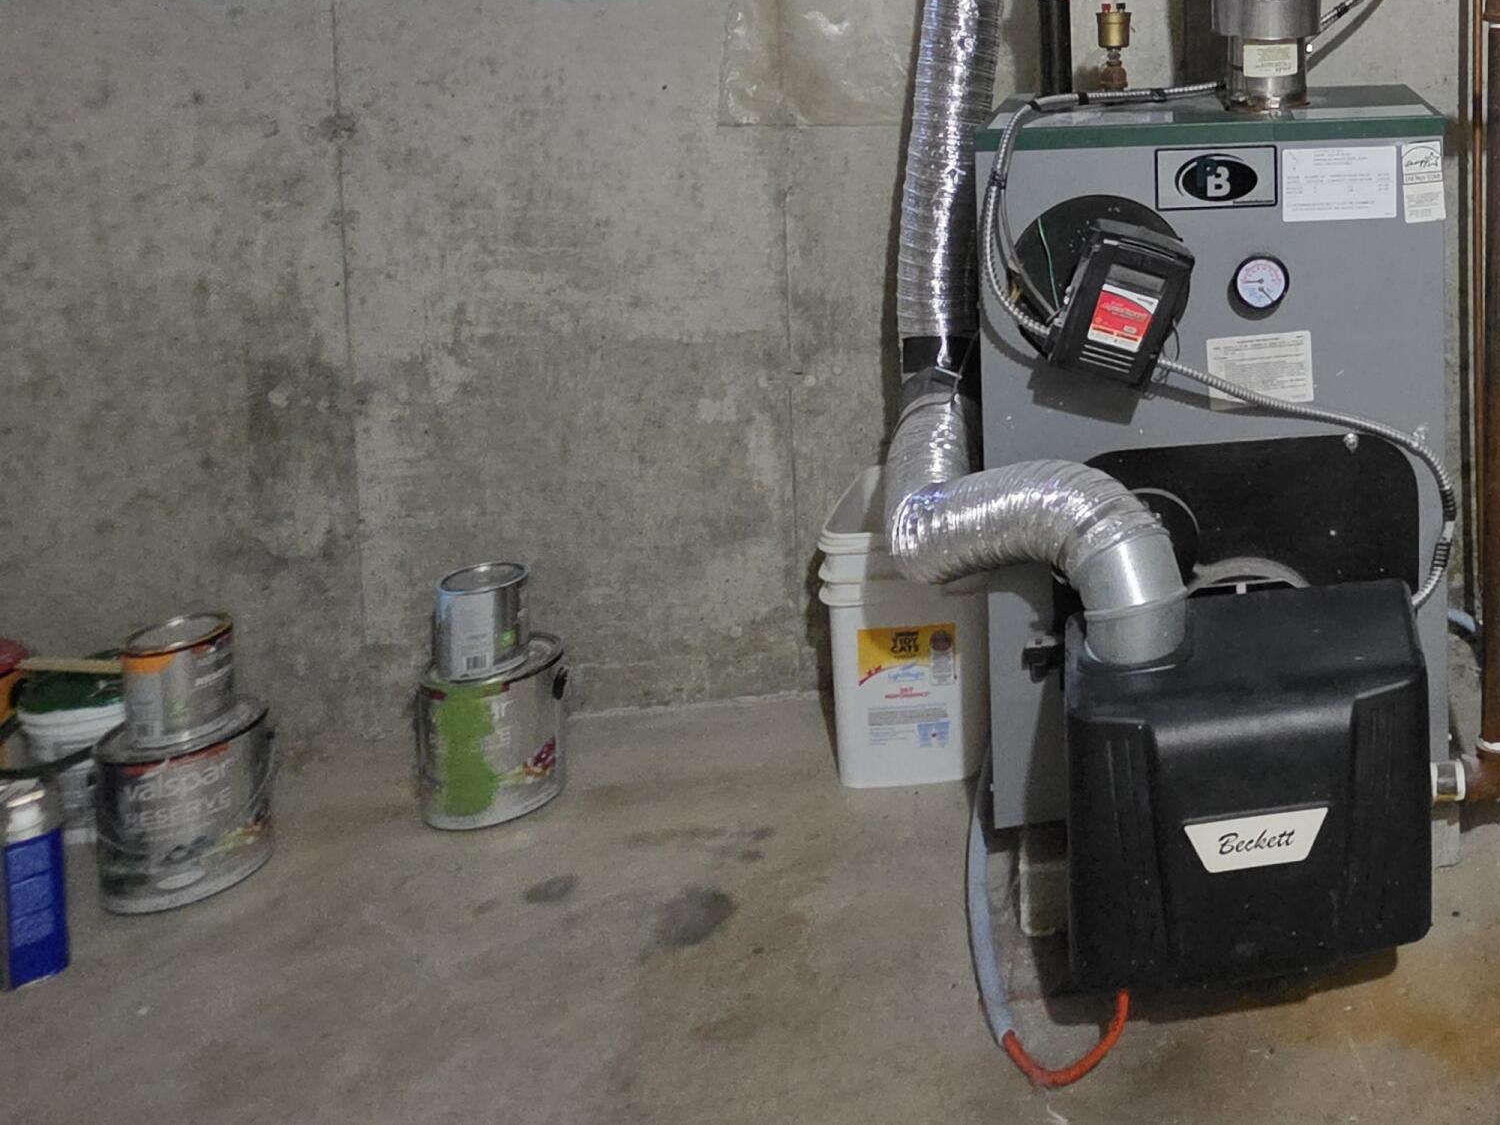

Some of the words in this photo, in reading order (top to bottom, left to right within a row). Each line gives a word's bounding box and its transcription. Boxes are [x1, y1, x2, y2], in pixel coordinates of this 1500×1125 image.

[123, 759, 232, 802] valspar
[125, 787, 231, 824] RESERVE
[1218, 829, 1295, 855] Beckett
